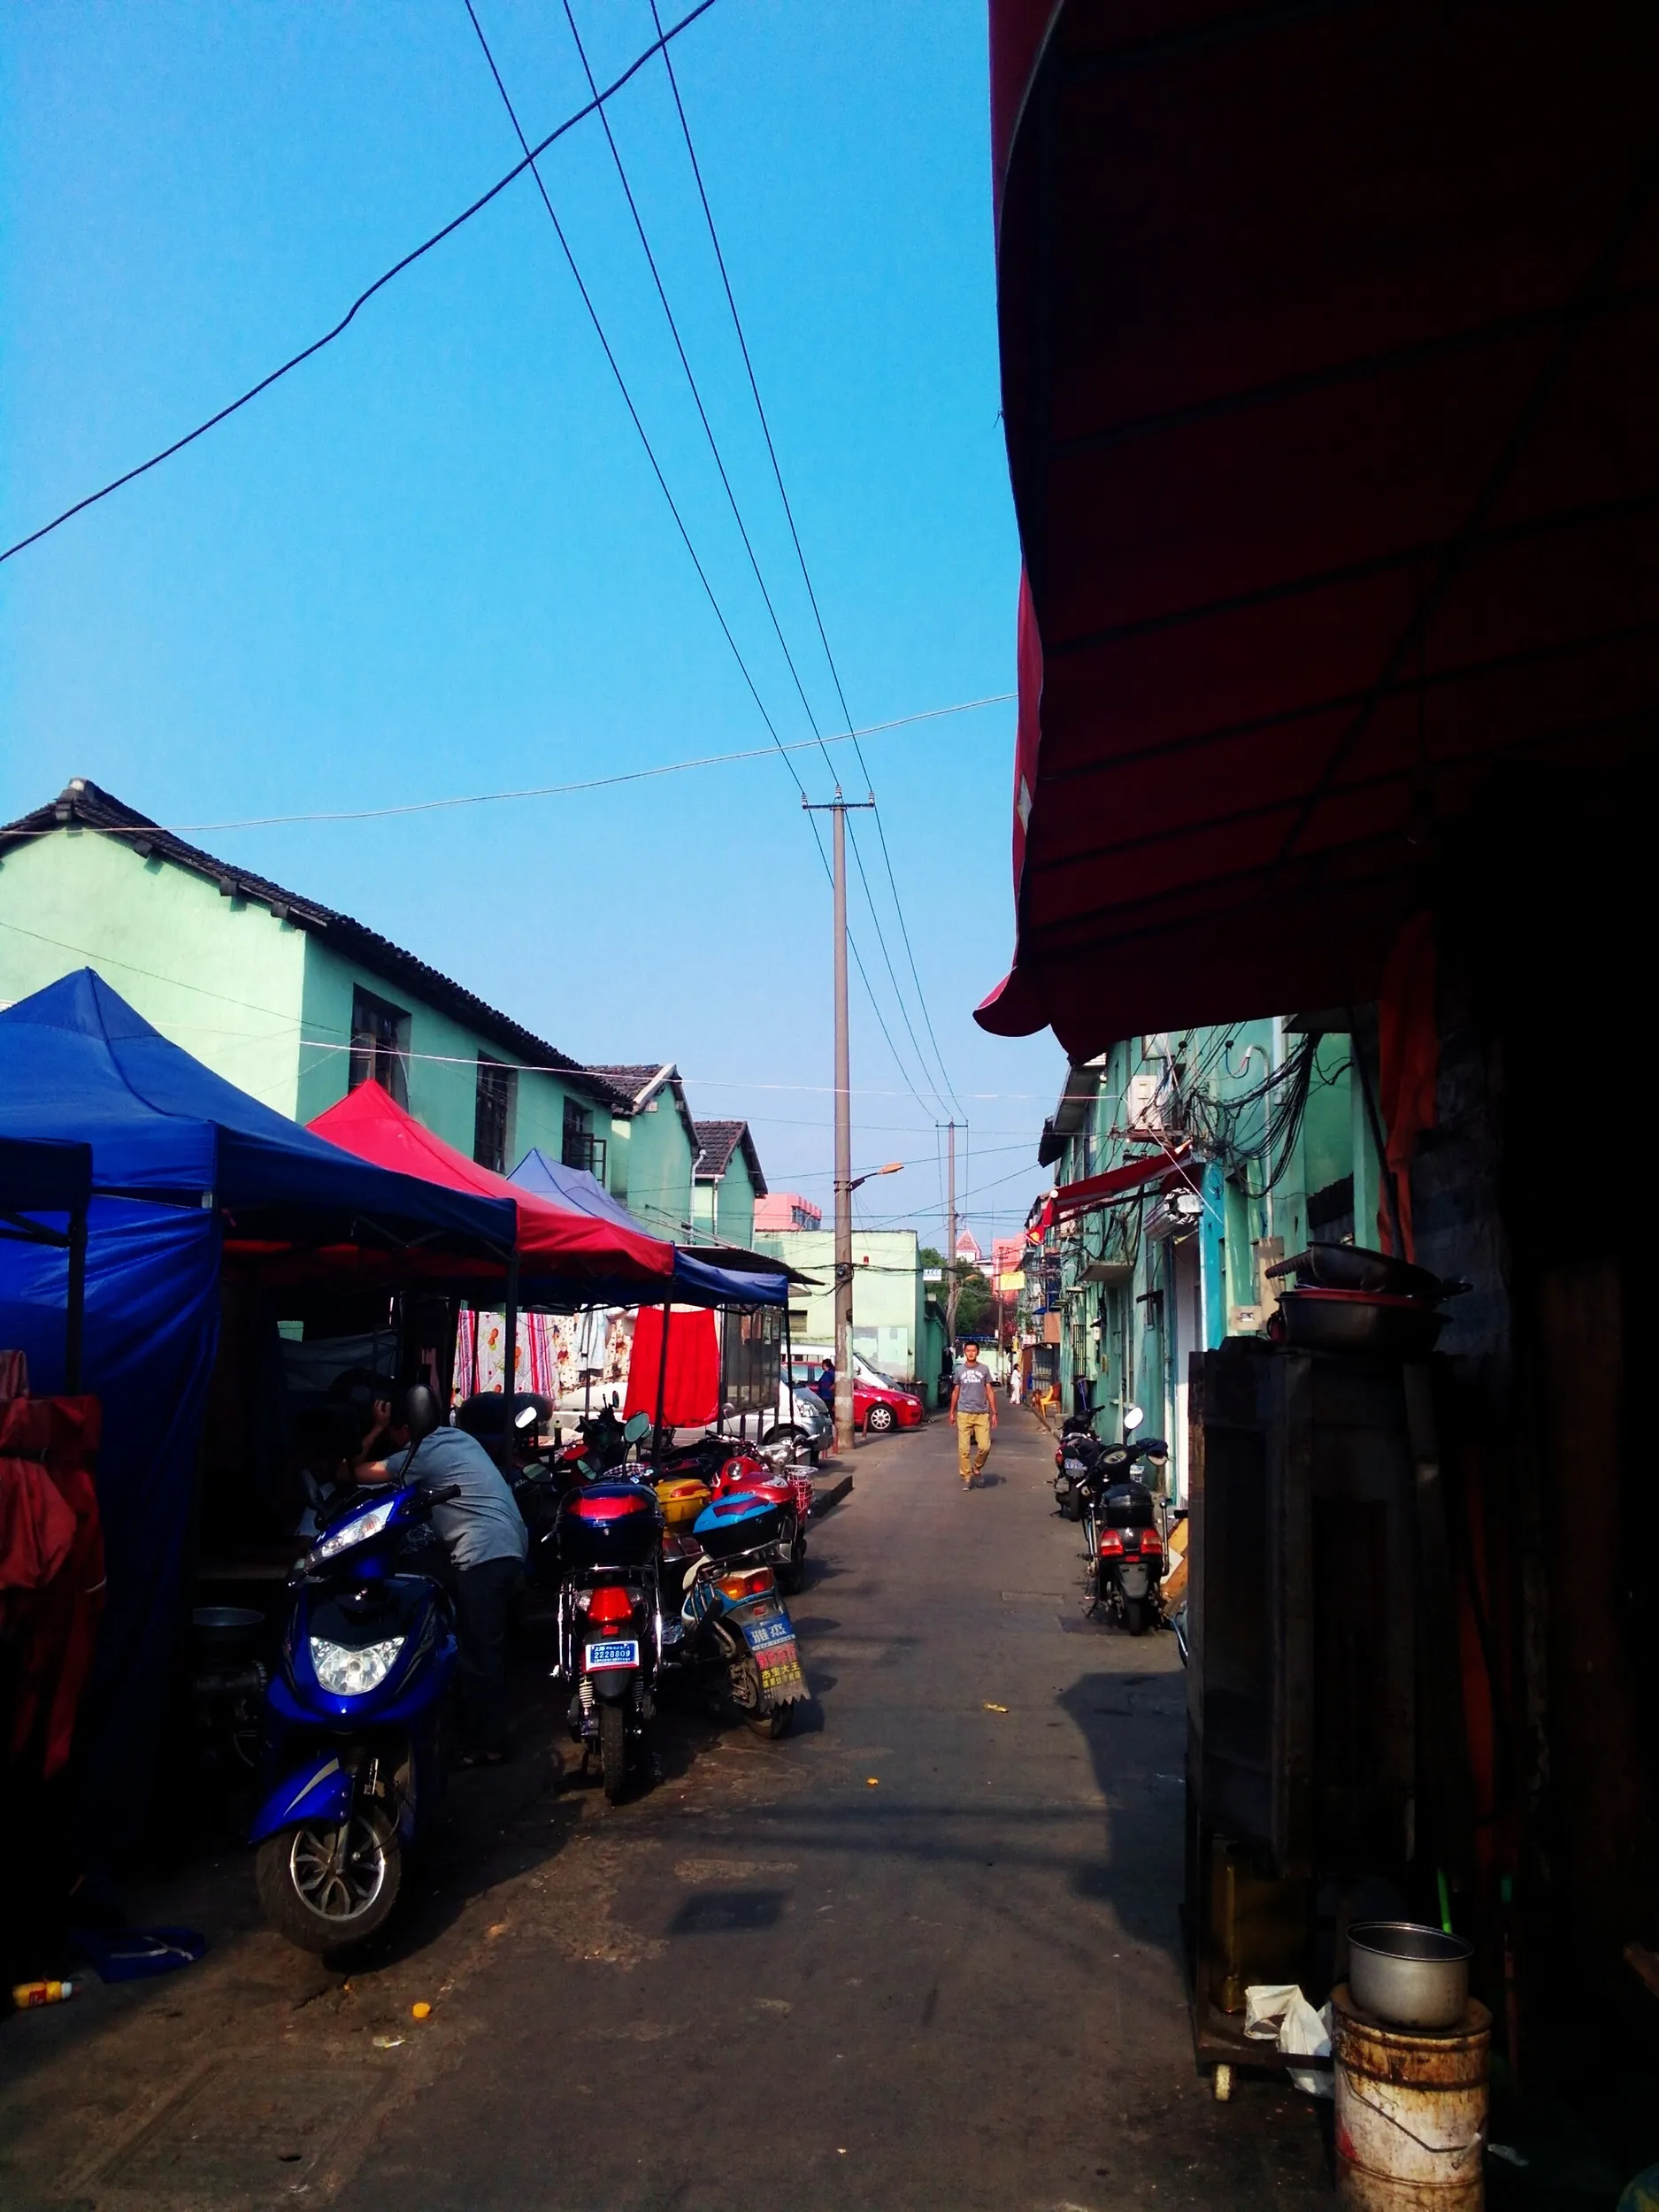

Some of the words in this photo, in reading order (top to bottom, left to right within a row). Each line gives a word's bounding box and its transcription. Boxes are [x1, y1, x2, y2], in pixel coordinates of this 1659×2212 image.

[594, 1649, 631, 1659] 2228809
[761, 1661, 801, 1679] 杰宝大王
